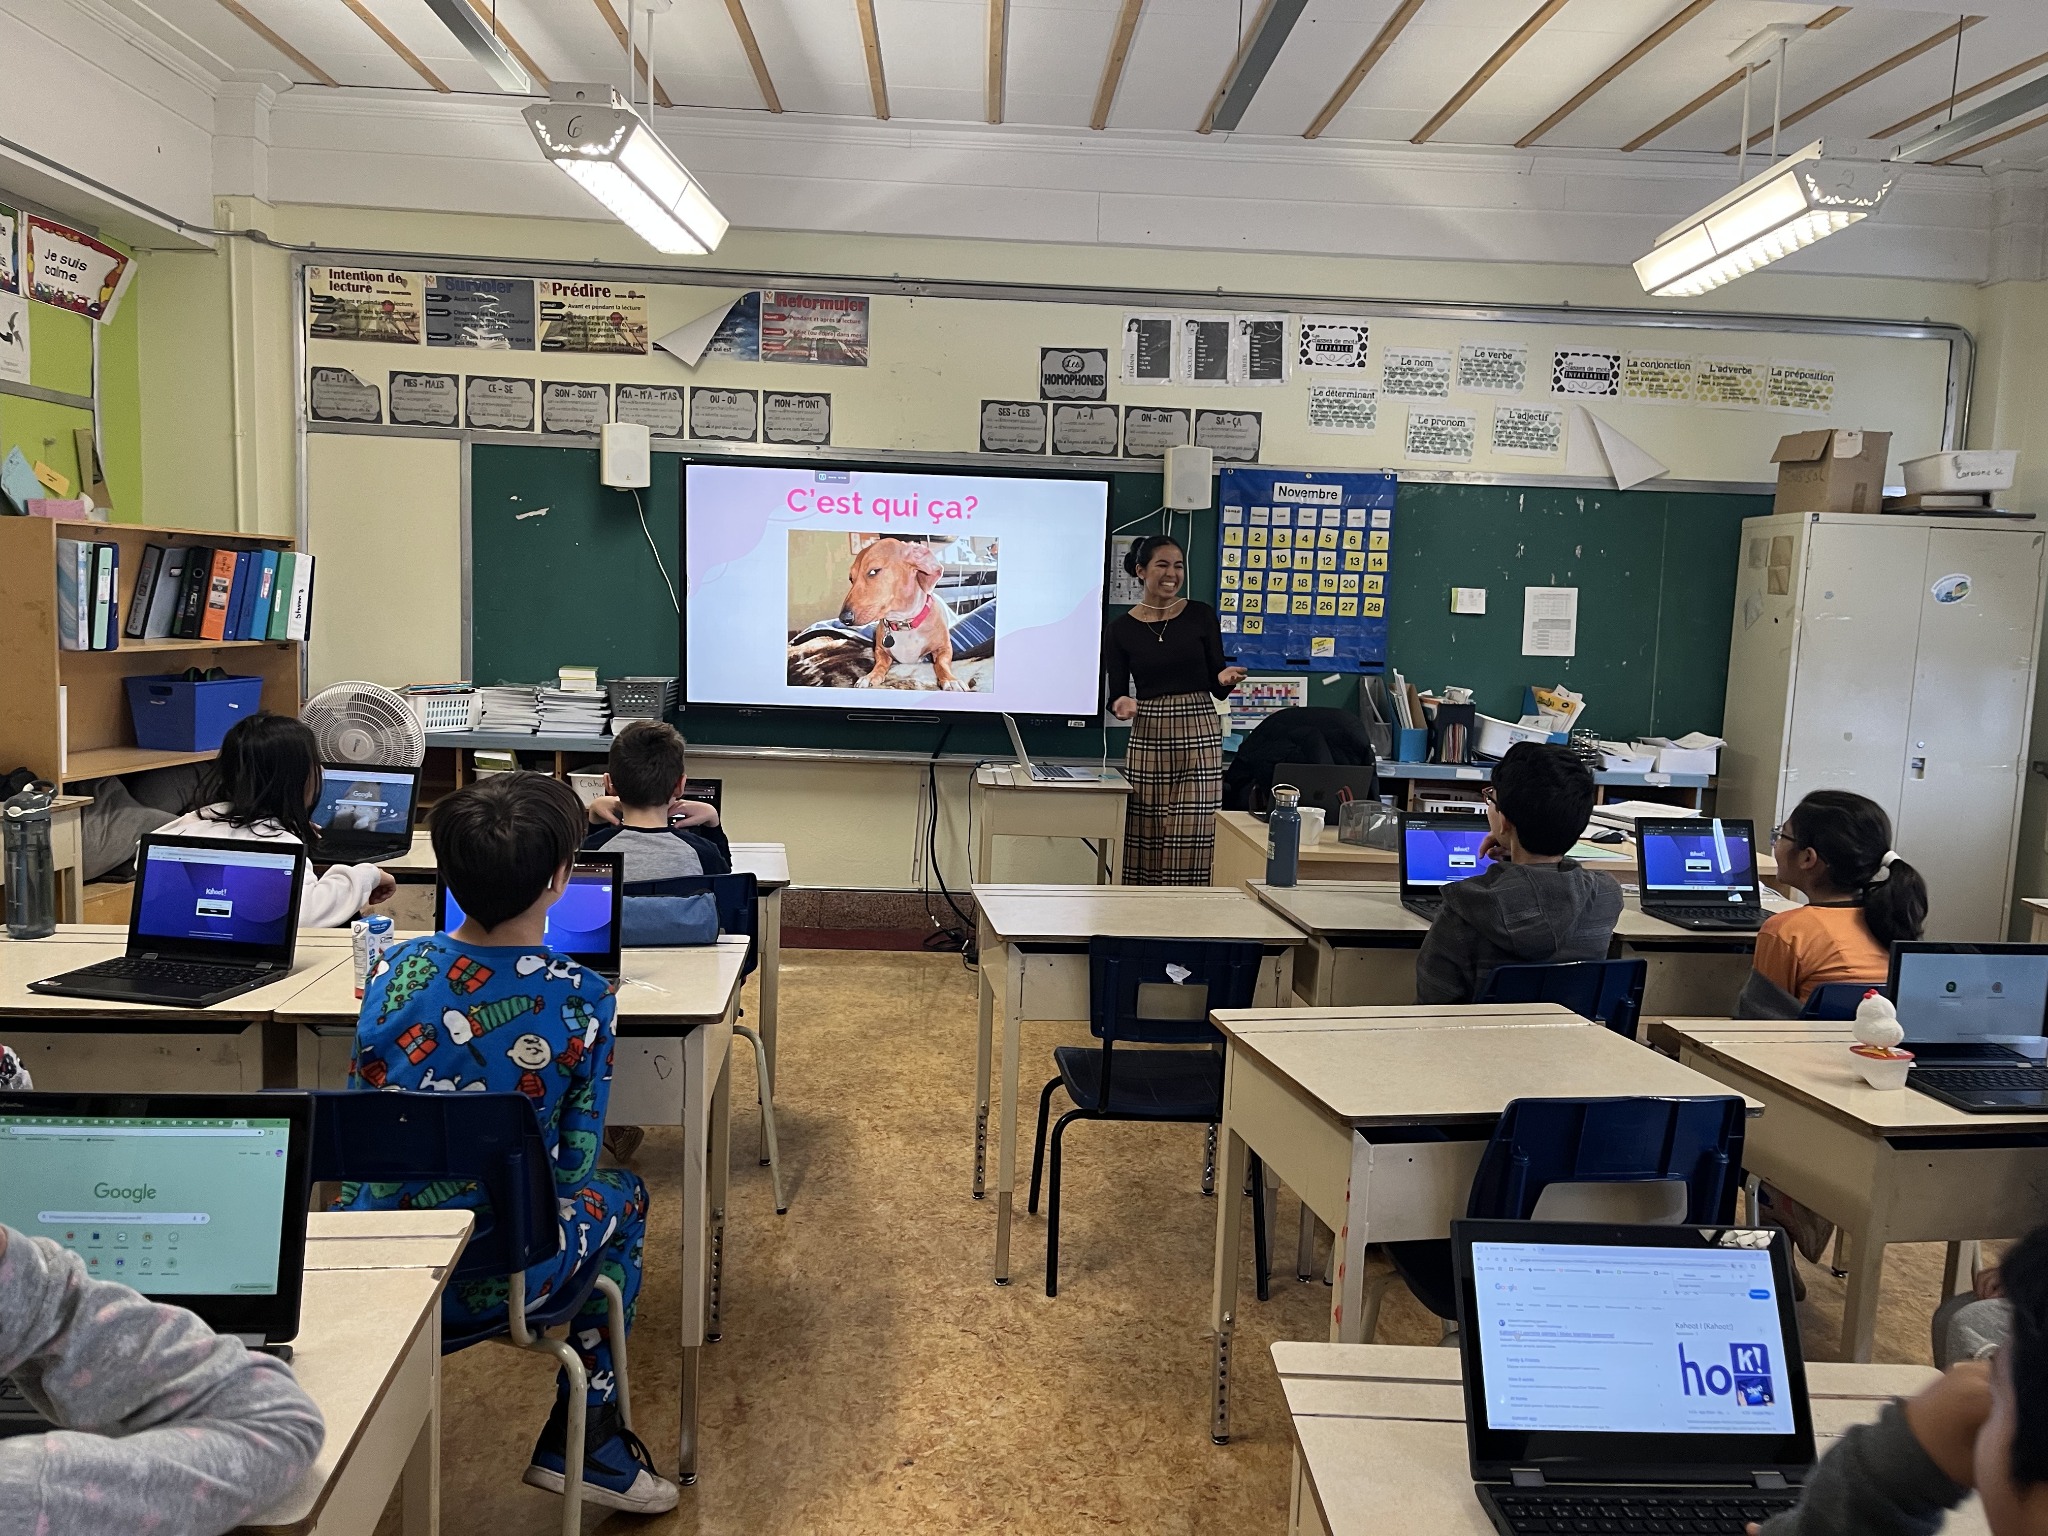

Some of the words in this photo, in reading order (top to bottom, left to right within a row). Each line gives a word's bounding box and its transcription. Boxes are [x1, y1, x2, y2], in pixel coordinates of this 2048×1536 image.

[568, 115, 582, 138] 6
[44, 249, 57, 262] Je
[60, 254, 88, 271] suis
[45, 265, 79, 284] calme.
[329, 269, 384, 282] Intention
[388, 273, 403, 283] de
[329, 281, 373, 293] lecture
[552, 282, 611, 298] Prédire
[776, 293, 866, 311] Reformuler
[1474, 350, 1485, 358] Le
[1488, 351, 1512, 359] verbe
[1066, 359, 1080, 368] Les
[1414, 359, 1433, 367] nom
[1640, 360, 1691, 370] conjonction
[1709, 364, 1752, 375] L'adverbe
[1771, 368, 1781, 376] La
[1785, 369, 1834, 382] préposition
[320, 373, 329, 382] LA
[1044, 374, 1104, 386] HOMOPHONES
[1565, 371, 1609, 380] INVARIABLES
[404, 379, 417, 387] MES
[425, 380, 444, 388] MAIS
[488, 384, 497, 393] CE
[504, 385, 513, 394] SE
[555, 389, 570, 398] SON
[577, 390, 598, 399] SONT
[621, 390, 633, 399] MA
[640, 391, 653, 400] M'A
[660, 391, 677, 401] M'AS
[710, 395, 720, 404] OU
[727, 394, 737, 404] OÙ
[1326, 389, 1375, 399] déterminant
[775, 399, 791, 408] MON
[798, 400, 820, 409] M'ONT
[998, 408, 1010, 417] SES
[1018, 409, 1030, 417] CES
[1077, 411, 1082, 420] A
[1509, 411, 1549, 421] L'adjectif
[1141, 414, 1151, 422] ON
[1158, 414, 1172, 423] ONT
[1216, 417, 1225, 425] SA
[1232, 417, 1242, 428] ÇA
[1431, 418, 1465, 426] pronom
[1278, 486, 1338, 499] Novembre
[787, 488, 863, 515] C'est
[872, 493, 918, 523] qui
[927, 495, 978, 524] ça?
[1254, 533, 1261, 542] 2
[1278, 534, 1286, 542] 3
[1301, 535, 1309, 543] 4
[1324, 534, 1332, 543] 5
[1349, 535, 1356, 545] 6
[1376, 536, 1383, 545] 7
[1228, 553, 1235, 562] 8
[1253, 554, 1260, 563] 9
[1276, 554, 1287, 563] 10
[1300, 556, 1308, 565] 11
[1322, 556, 1332, 566] 12
[1350, 557, 1360, 566] 13
[1372, 558, 1383, 567] 14
[1225, 575, 1235, 585] 15
[1247, 576, 1258, 585] 16
[1273, 577, 1283, 586] 17
[1298, 578, 1308, 587] 18
[1324, 578, 1334, 588] 19
[1343, 579, 1356, 588] 20
[1368, 580, 1379, 589] 21
[1224, 597, 1236, 606] 22
[1246, 598, 1259, 608] 23
[1295, 600, 1308, 610] 25
[1319, 601, 1333, 610] 26
[1341, 602, 1355, 611] 27
[1367, 602, 1381, 612] 28
[1246, 620, 1260, 629] 30
[94, 1182, 157, 1203] Google
